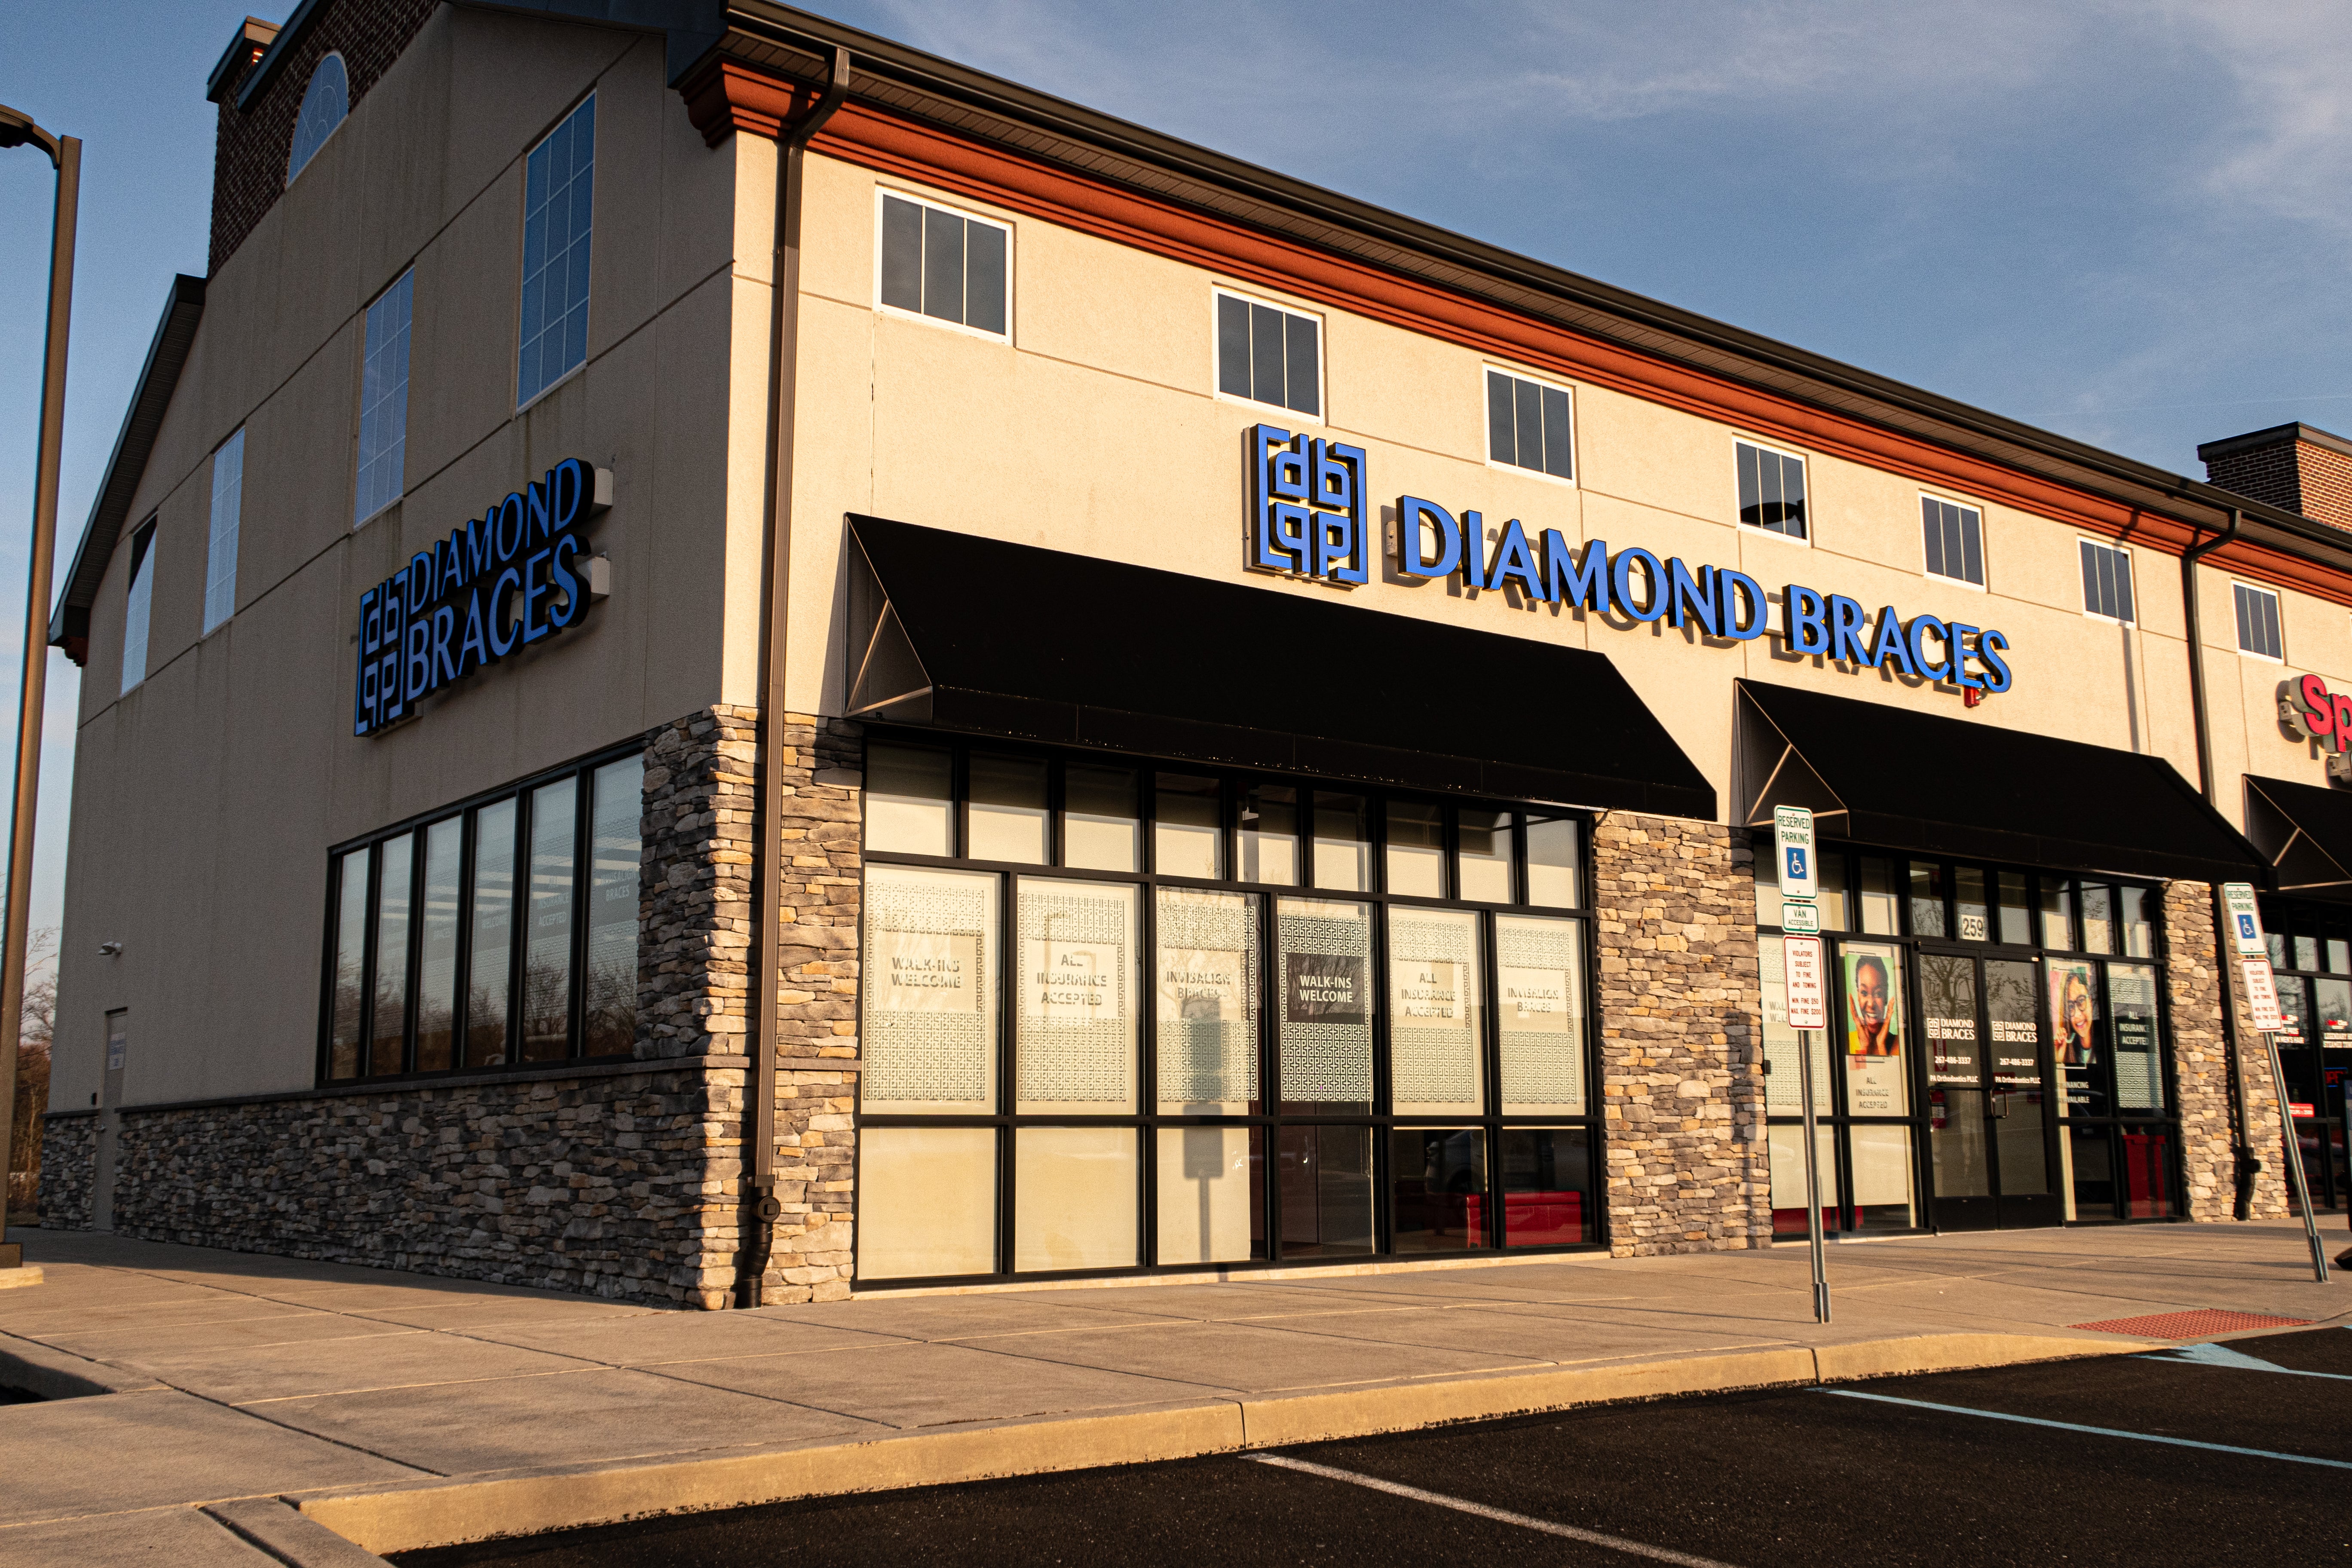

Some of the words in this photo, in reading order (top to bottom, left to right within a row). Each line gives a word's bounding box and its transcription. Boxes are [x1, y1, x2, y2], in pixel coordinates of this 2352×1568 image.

[410, 458, 585, 616] DIAMOND
[1397, 495, 1767, 640] DIAMOND
[1782, 584, 2012, 693] BRACES
[407, 534, 580, 701] BRACES
[1778, 815, 1810, 829] RESERVED
[1781, 831, 1809, 844] PARKING
[606, 885, 630, 902] BRACES
[1793, 909, 1807, 918] VAN
[2231, 903, 2254, 911] PARKING
[1963, 917, 1984, 937] 259
[892, 957, 960, 973] WALK-INS
[891, 974, 961, 988] WELCOME
[1037, 972, 1107, 987] INSURANCE
[1167, 971, 1230, 985] INVISALIGN
[1299, 975, 1352, 989] WALK-INS
[1419, 973, 1437, 984] ALL
[1041, 992, 1102, 1006] ACCEPTED
[1299, 989, 1353, 1003] WELCOME
[1401, 989, 1456, 1001] INSURANCE
[1507, 987, 1559, 1000] INVISALIGN
[1405, 1006, 1453, 1018] ACCEPTED
[2128, 1011, 2139, 1020] ALL
[1940, 1018, 1975, 1029] DIAMOND
[2005, 1021, 2037, 1031] DIAMOND
[2119, 1023, 2150, 1032] INSURANCE
[1941, 1029, 1975, 1040] BRACES
[2006, 1031, 2038, 1043] BRACES
[2122, 1036, 2149, 1045] ACCEPTED
[1935, 1056, 1972, 1064] 267-486-3337
[1999, 1058, 2034, 1066] 267-486-3337
